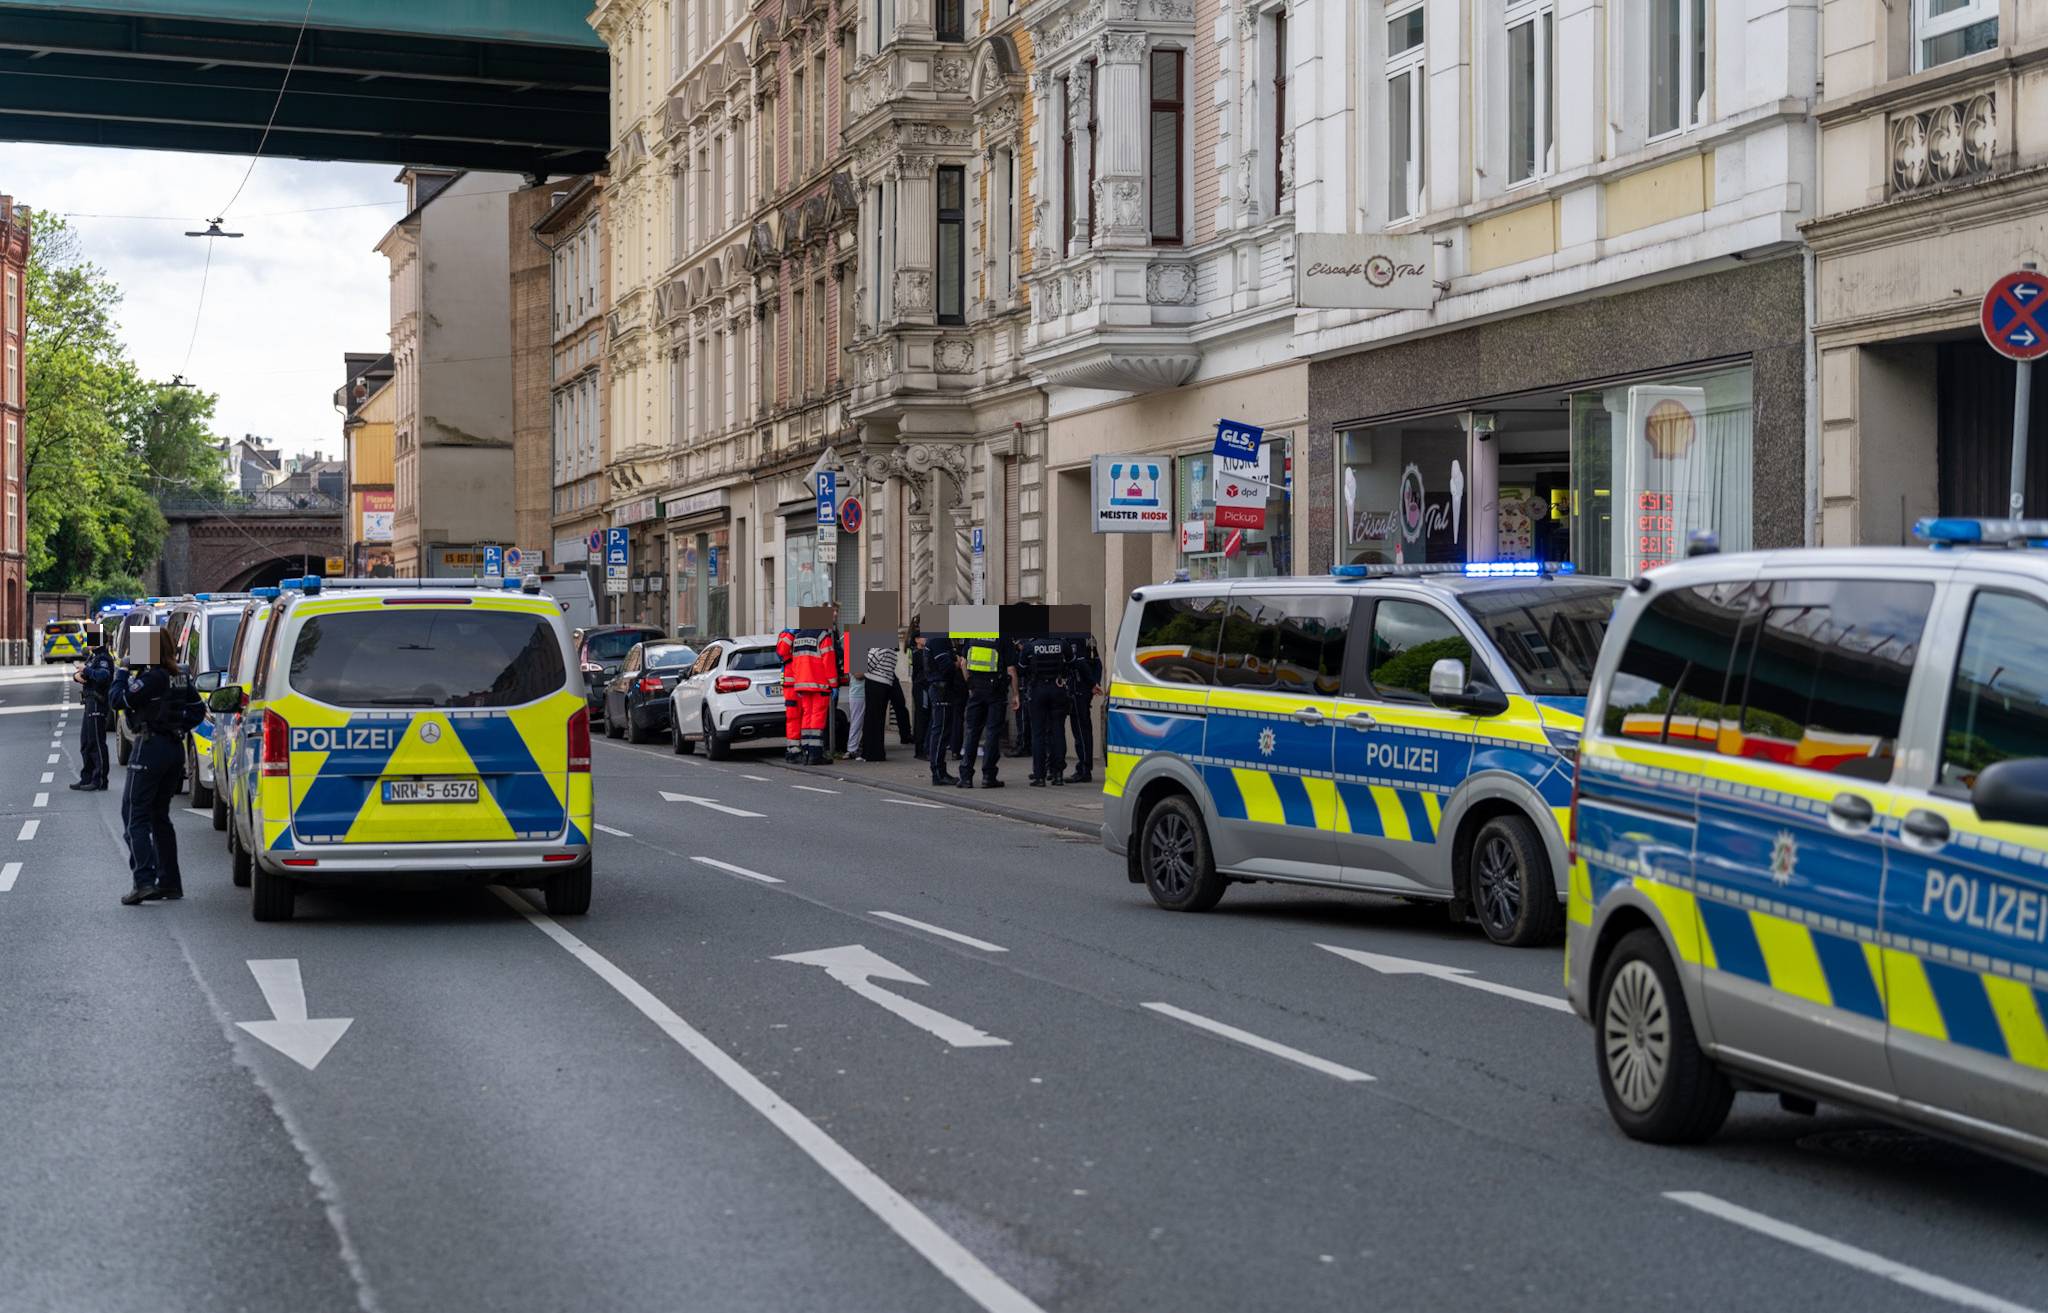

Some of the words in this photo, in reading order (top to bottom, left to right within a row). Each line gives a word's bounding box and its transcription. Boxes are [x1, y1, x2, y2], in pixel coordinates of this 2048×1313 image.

[1306, 262, 1362, 277] Eiscafé
[1396, 263, 1425, 278] Tal
[1221, 429, 1251, 446] GLS
[1241, 487, 1258, 498] dpd
[1100, 510, 1138, 520] MEISTER
[1141, 511, 1168, 521] KIOSK
[1224, 511, 1258, 522] Pickup
[1355, 509, 1399, 542] Eiscafé
[1425, 501, 1449, 539] Tal
[1034, 644, 1062, 654] POLIZEI
[292, 728, 394, 750] POLIZEI
[1366, 742, 1439, 774] POLIZEI
[391, 783, 420, 799] NRW
[426, 783, 477, 798] 5-6576
[1922, 867, 2048, 943] POLIZEI
